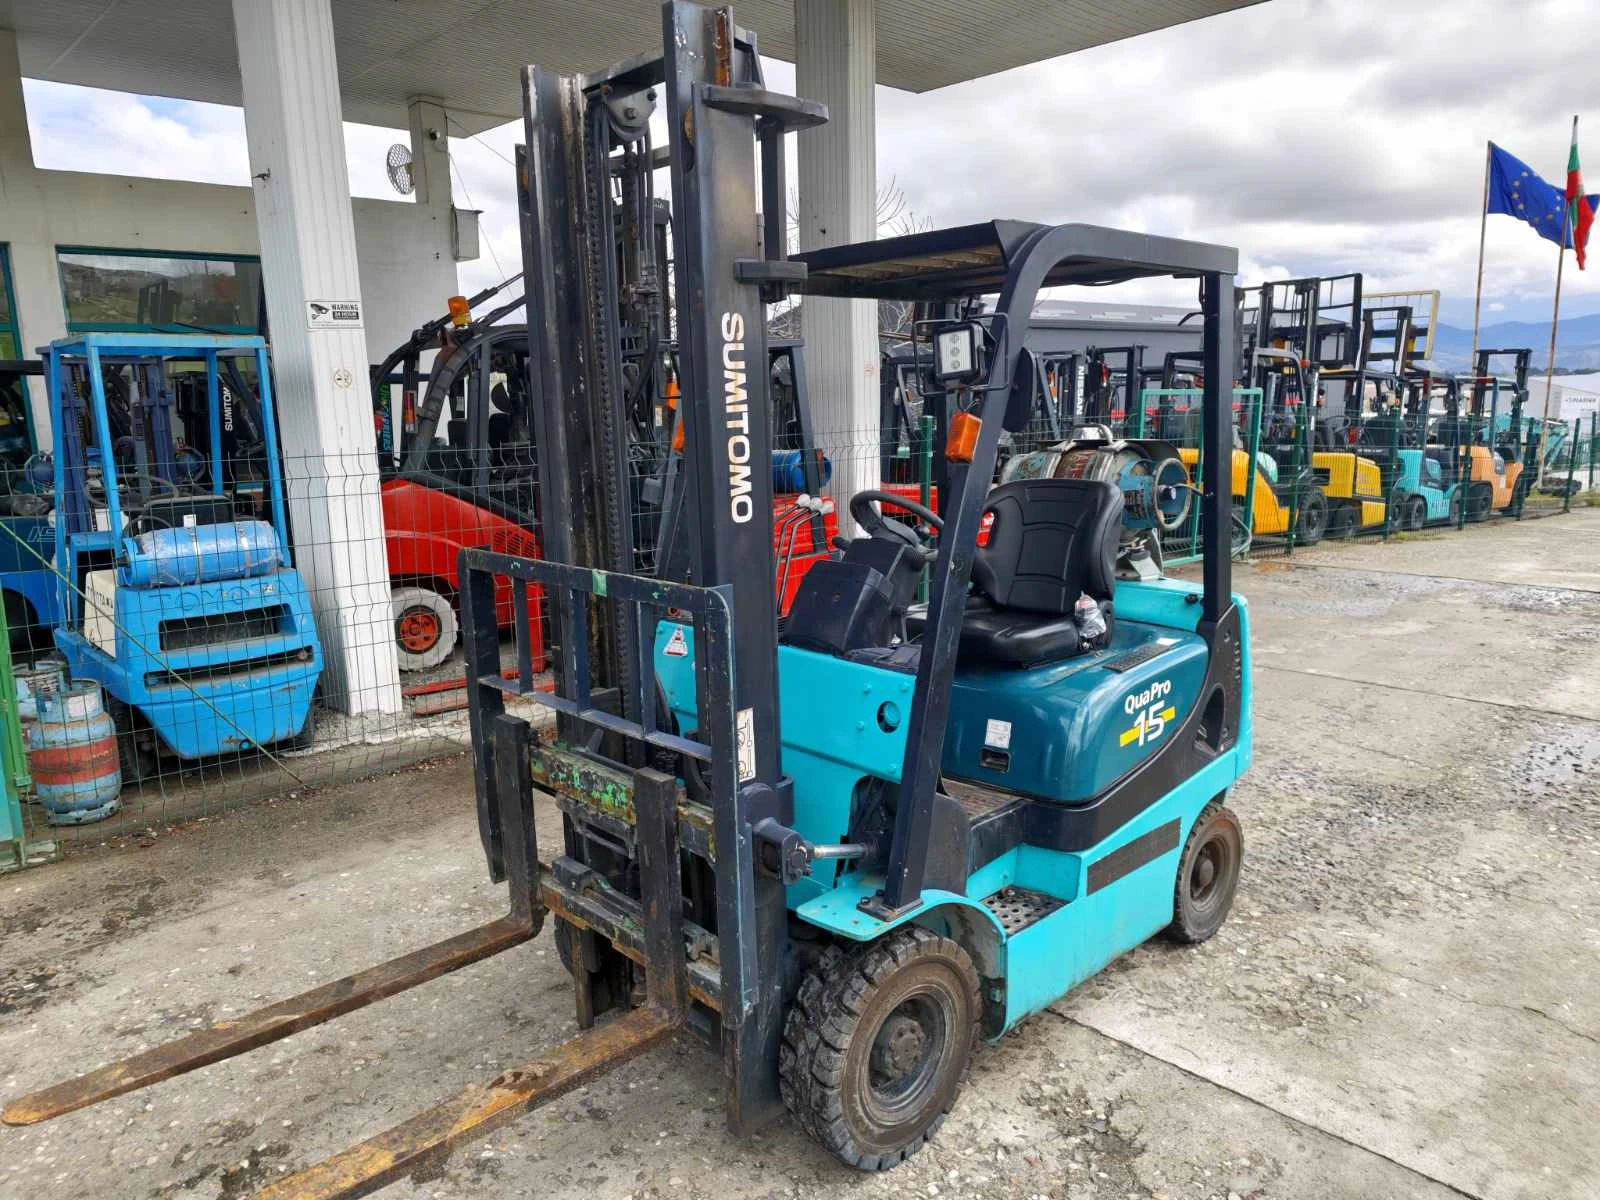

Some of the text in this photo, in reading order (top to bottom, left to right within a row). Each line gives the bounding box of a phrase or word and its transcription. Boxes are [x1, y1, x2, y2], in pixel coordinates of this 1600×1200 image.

[1076, 365, 1085, 416] NISSAN
[721, 311, 753, 524] SUMITOMO
[149, 578, 296, 612] TOYOTA
[1124, 679, 1171, 715] QuaPro
[1133, 700, 1165, 747] 15
